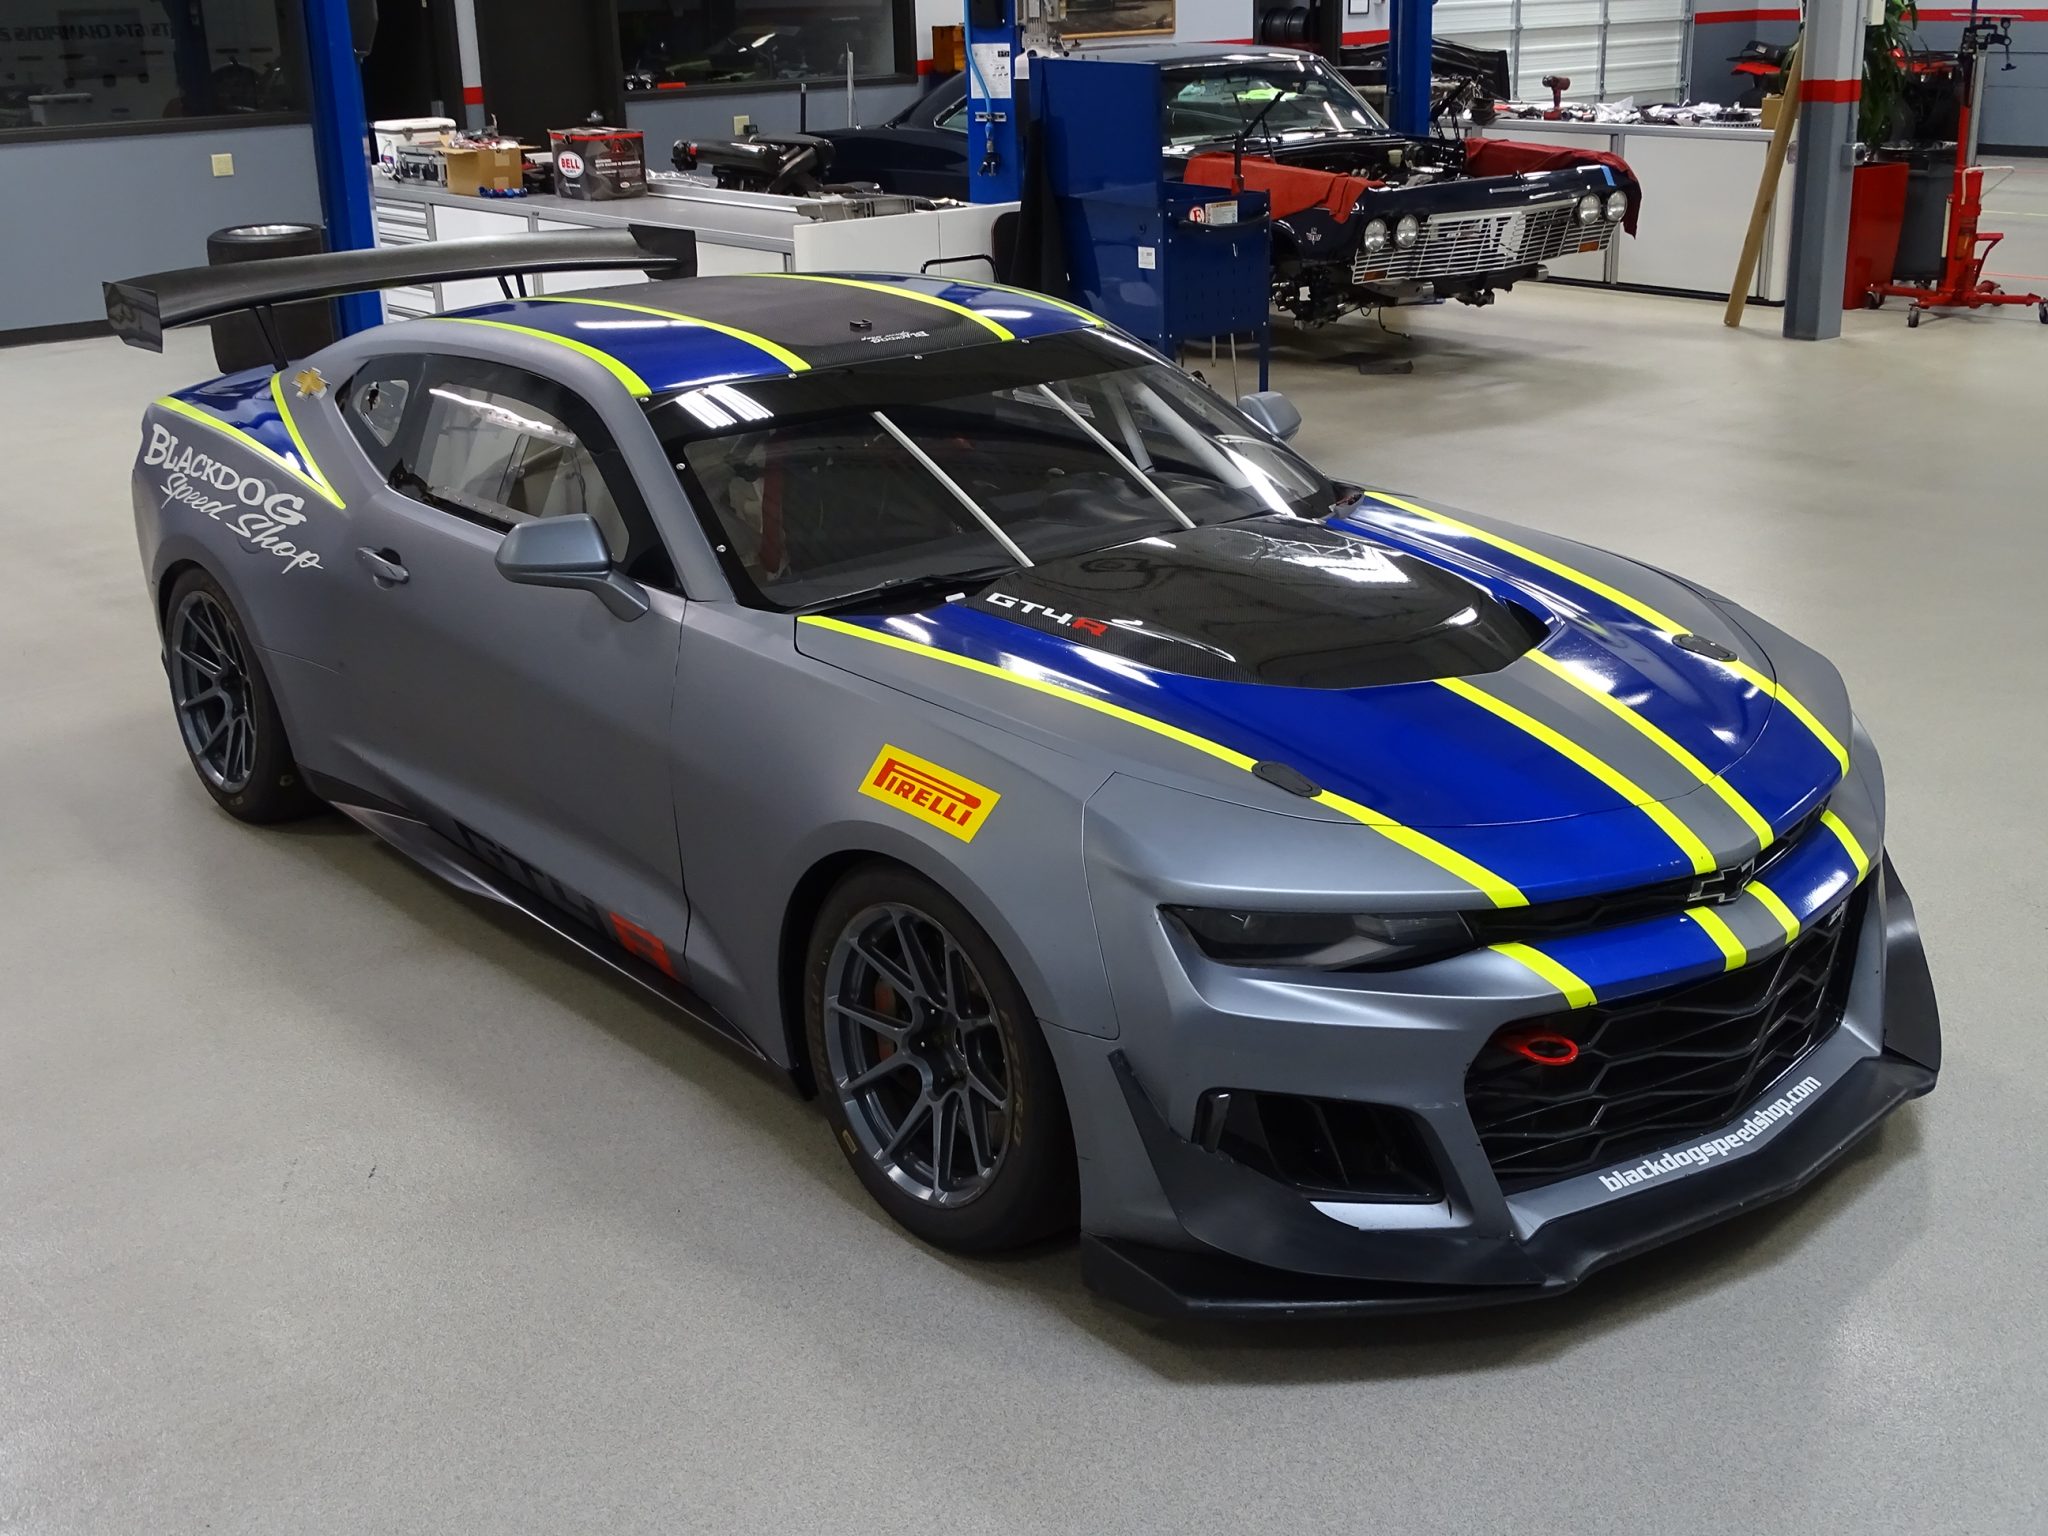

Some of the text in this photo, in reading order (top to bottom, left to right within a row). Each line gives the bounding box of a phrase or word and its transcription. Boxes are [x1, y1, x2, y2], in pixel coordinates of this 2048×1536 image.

[561, 158, 580, 169] BELL
[144, 423, 307, 526] BLACKDOG
[160, 473, 324, 574] Speed Shop
[872, 757, 982, 827] PIRELLI
[1598, 1075, 1822, 1192] blackdogspeedshop.com
